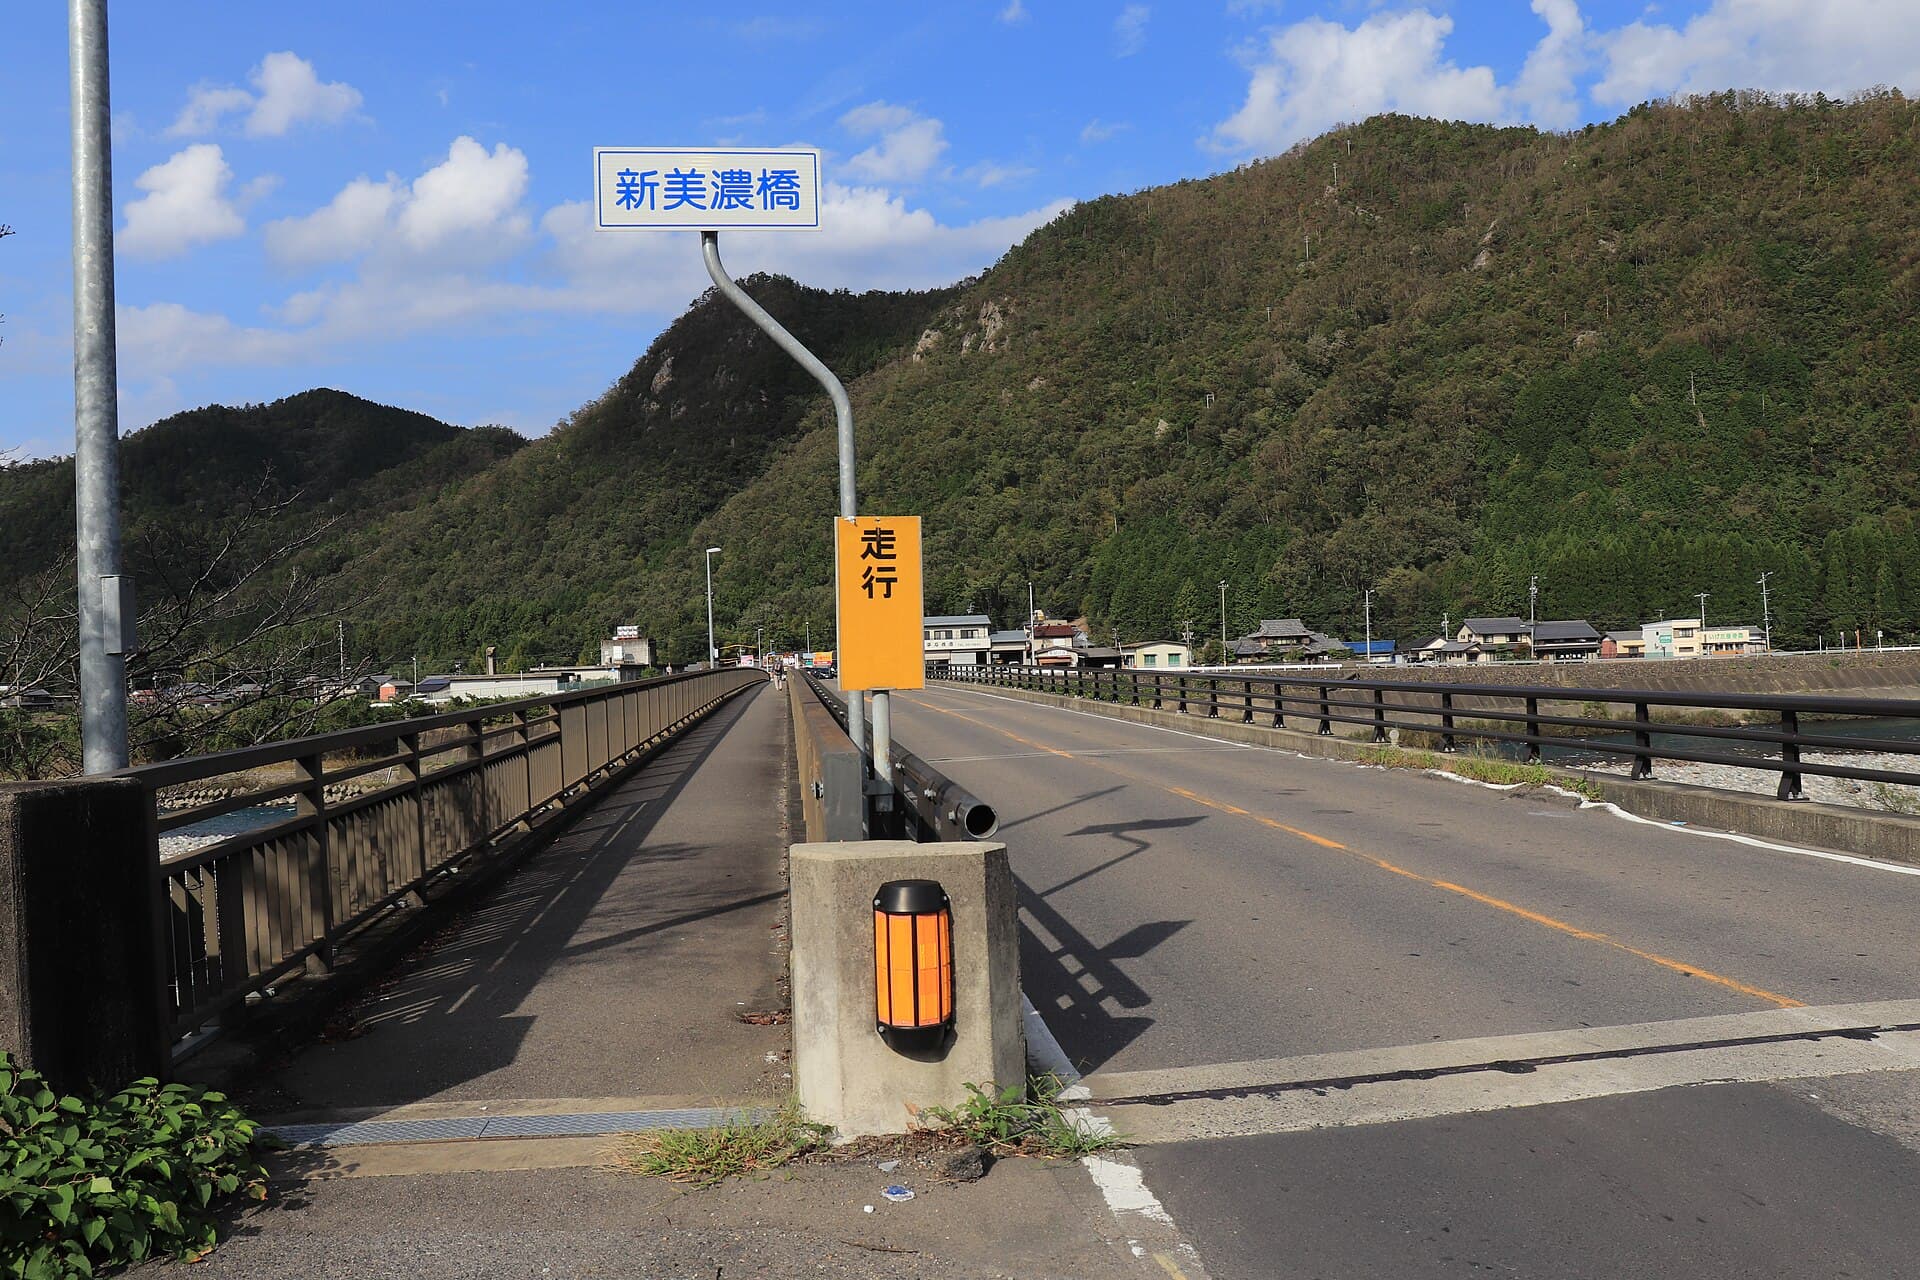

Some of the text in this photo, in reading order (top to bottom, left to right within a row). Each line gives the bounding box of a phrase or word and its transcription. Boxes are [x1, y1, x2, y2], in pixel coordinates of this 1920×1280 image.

[616, 168, 801, 210] 新美濃橋
[861, 527, 898, 599] 走行
